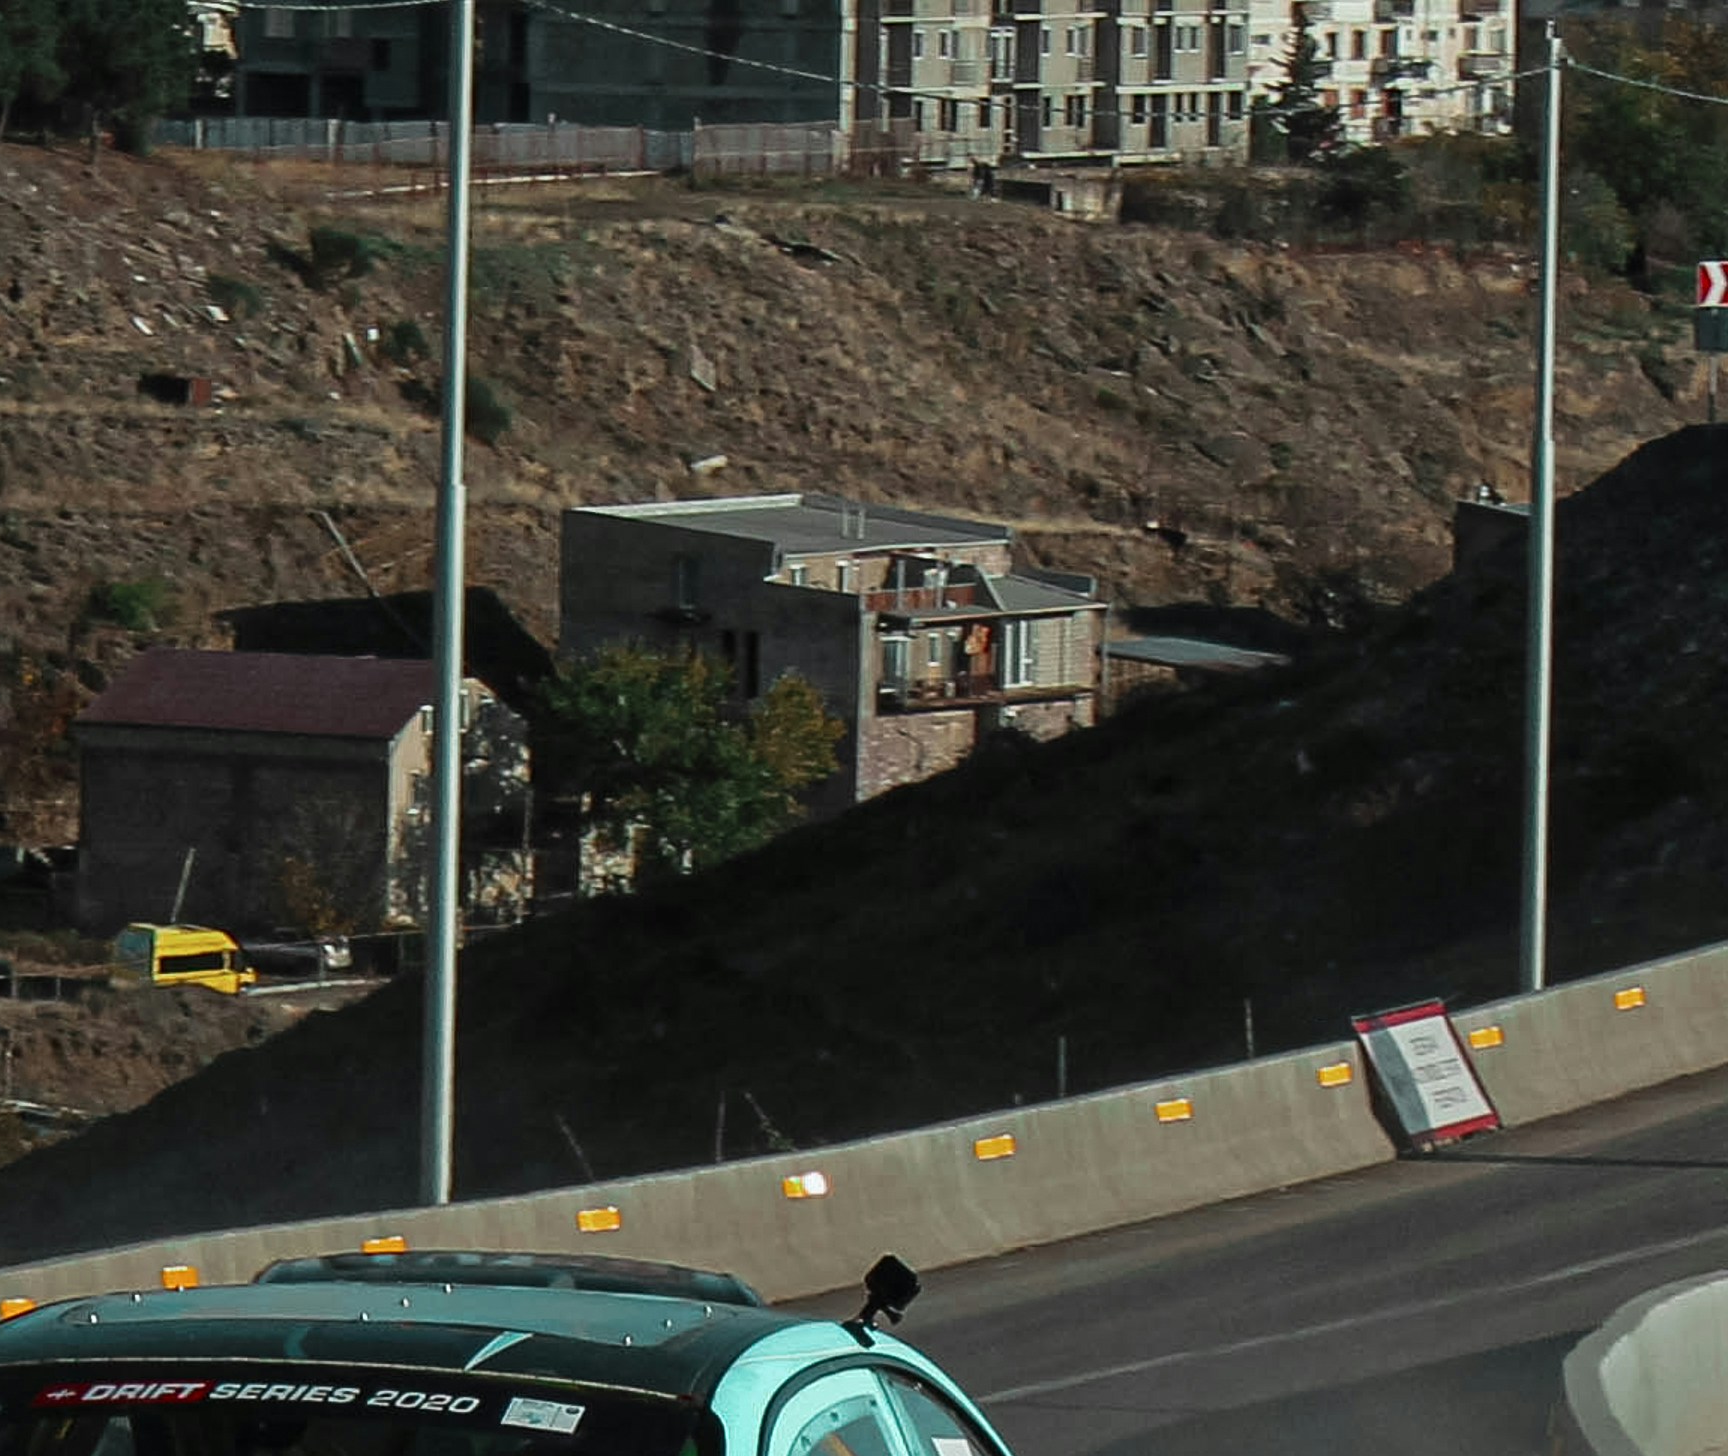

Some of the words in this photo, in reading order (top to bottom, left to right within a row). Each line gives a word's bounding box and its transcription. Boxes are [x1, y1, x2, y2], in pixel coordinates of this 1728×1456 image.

[82, 1382, 206, 1401] DRIFT
[209, 1383, 361, 1404] SERIES
[366, 1389, 481, 1414] 2020
